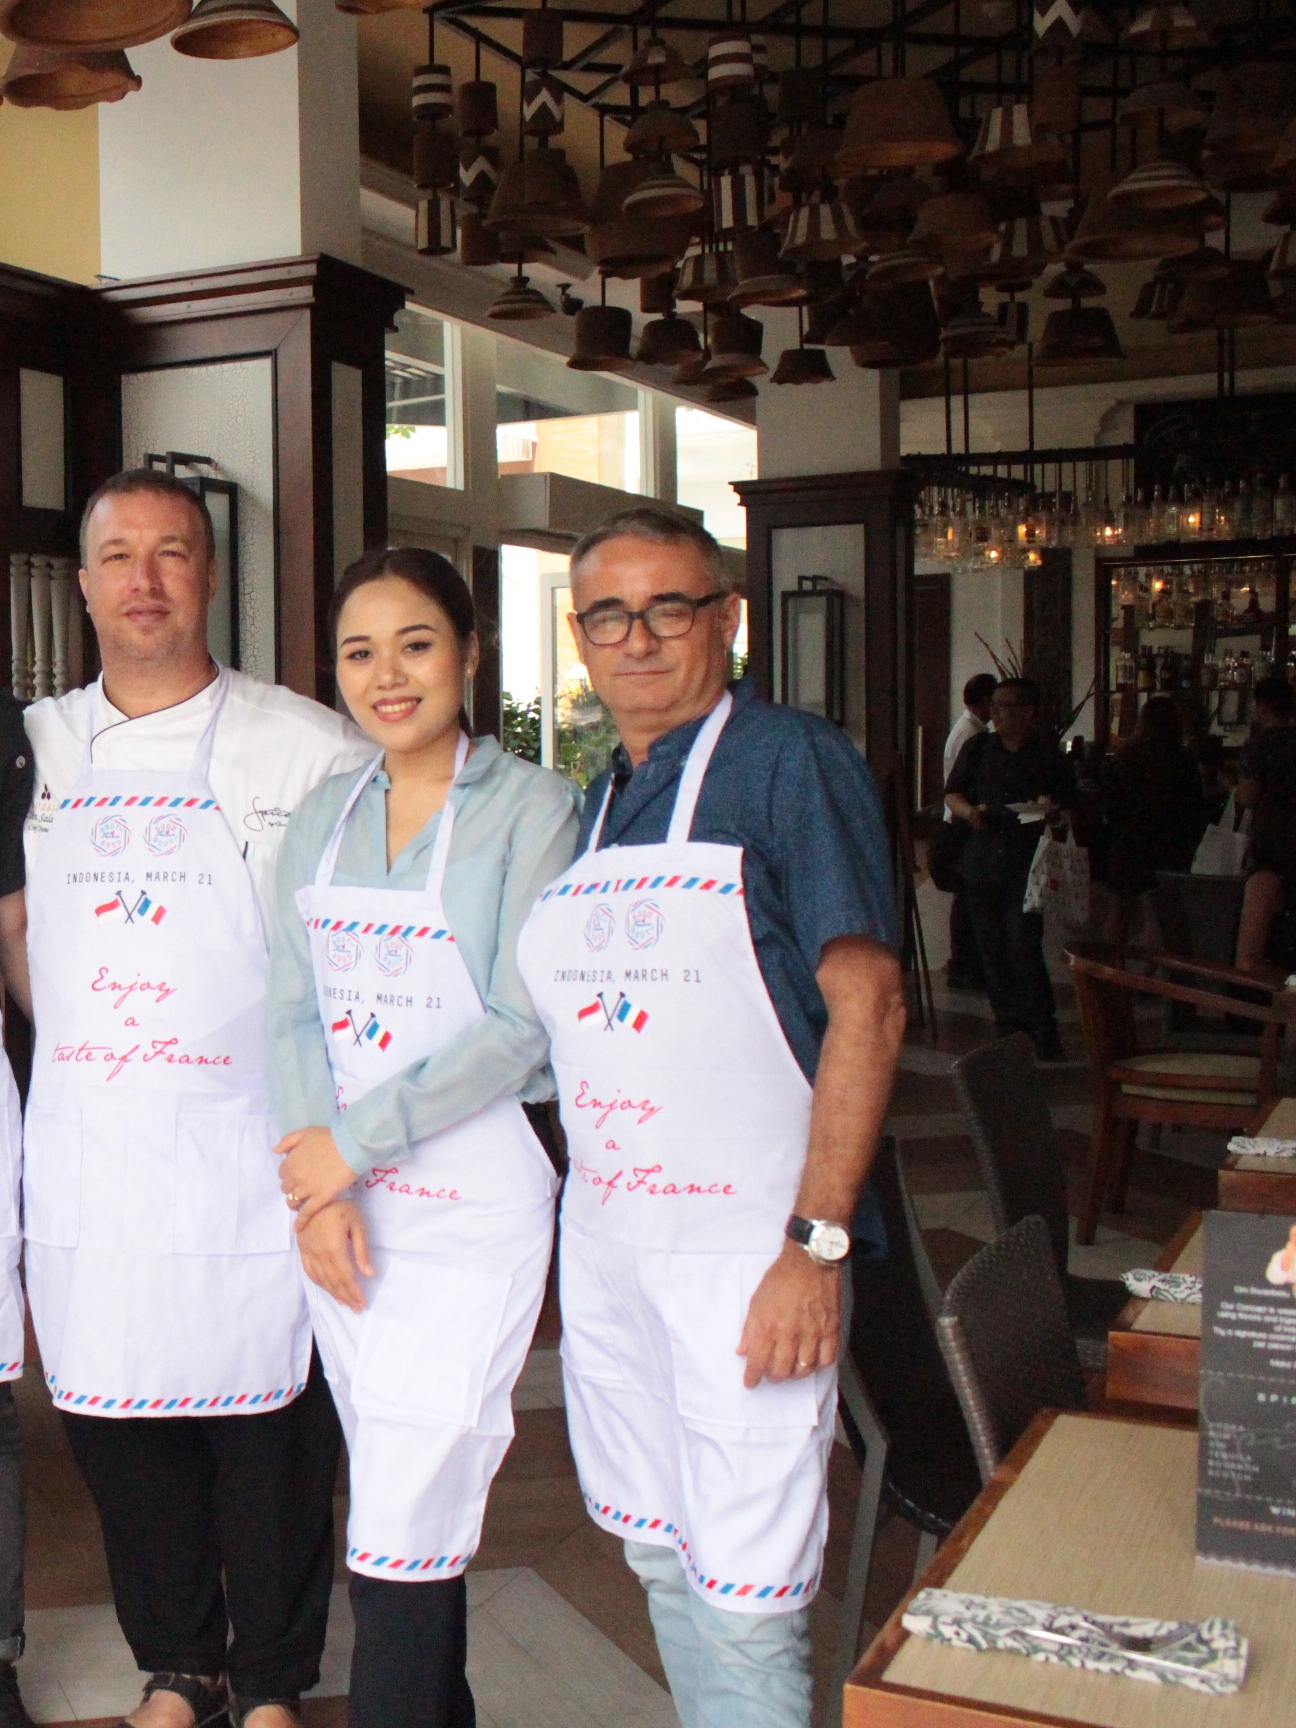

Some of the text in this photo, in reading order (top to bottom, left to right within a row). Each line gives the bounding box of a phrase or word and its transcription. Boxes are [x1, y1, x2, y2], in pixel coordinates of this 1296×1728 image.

[66, 871, 213, 885] INDONESIA, MARCH 21
[91, 966, 178, 1010] Enjoy
[553, 968, 702, 984] INDONESIA, MARCH 21
[376, 993, 413, 1008] MARCH
[425, 997, 442, 1009] 21
[124, 1016, 140, 1027] a
[52, 1037, 233, 1082] taste of France
[574, 1080, 664, 1129] Enjoy
[604, 1139, 621, 1151] a
[365, 1166, 462, 1201] France
[592, 1169, 624, 1206] of
[626, 1164, 738, 1196] France
